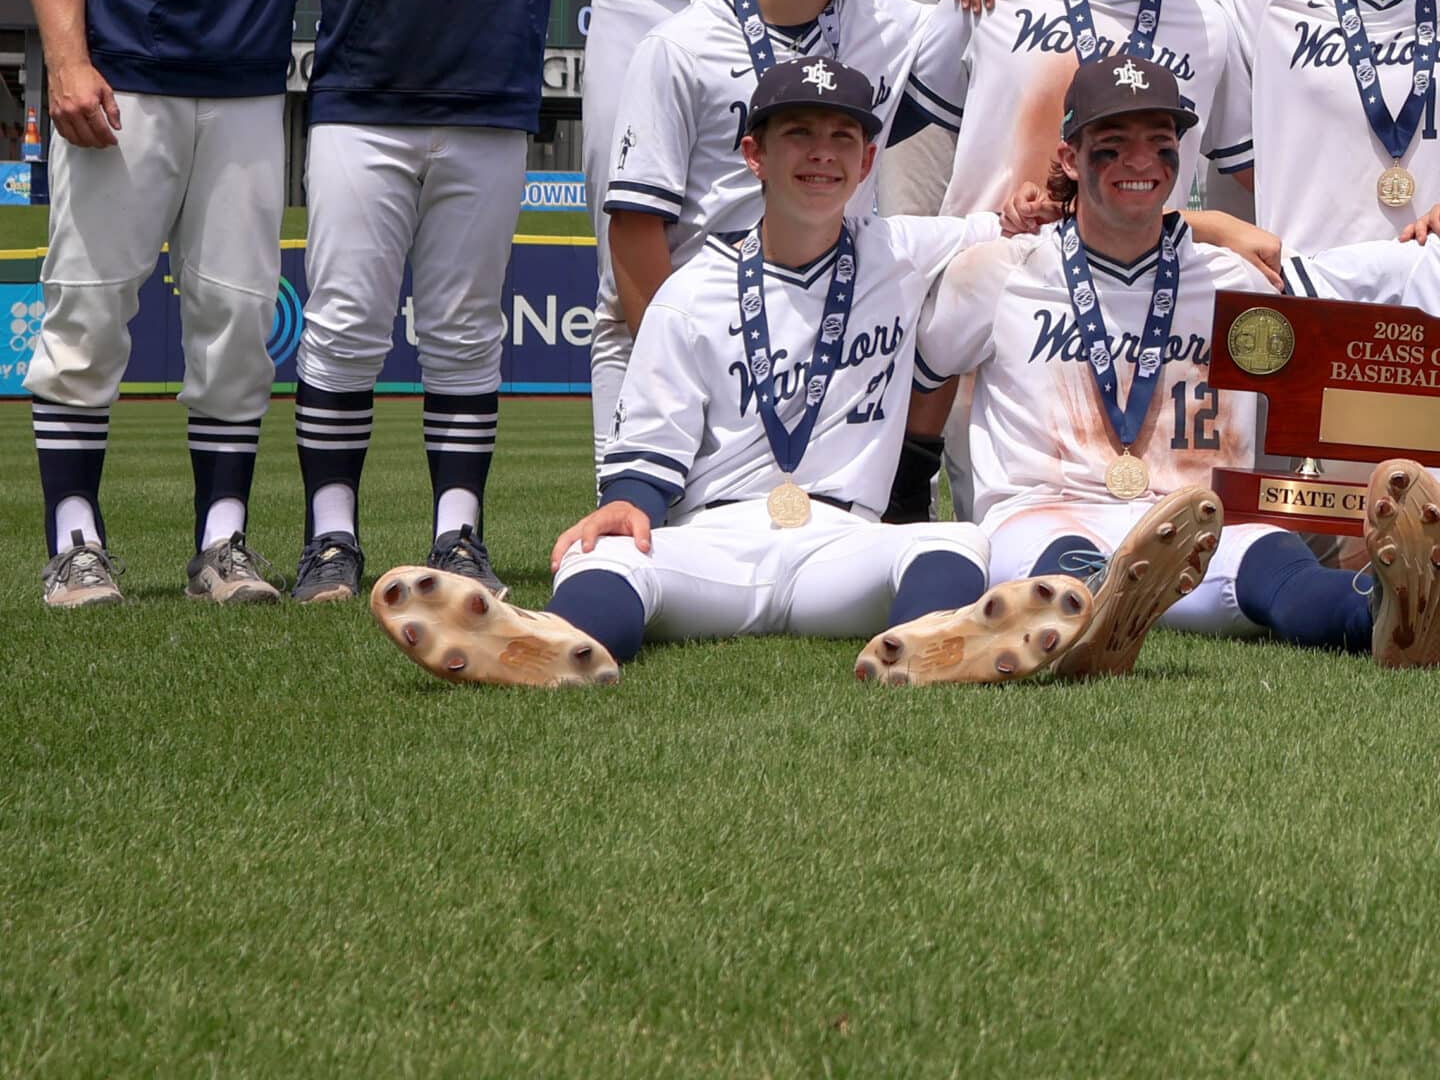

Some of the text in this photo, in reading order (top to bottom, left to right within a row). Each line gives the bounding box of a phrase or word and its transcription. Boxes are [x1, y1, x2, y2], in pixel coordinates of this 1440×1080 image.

[1011, 8, 1196, 81] Warirs
[1028, 309, 1211, 366] Waror
[1346, 340, 1425, 366] CLASS
[1373, 321, 1425, 342] 2026
[728, 315, 905, 418] Warors
[1170, 380, 1221, 450] 12
[1265, 487, 1336, 508] STATE
